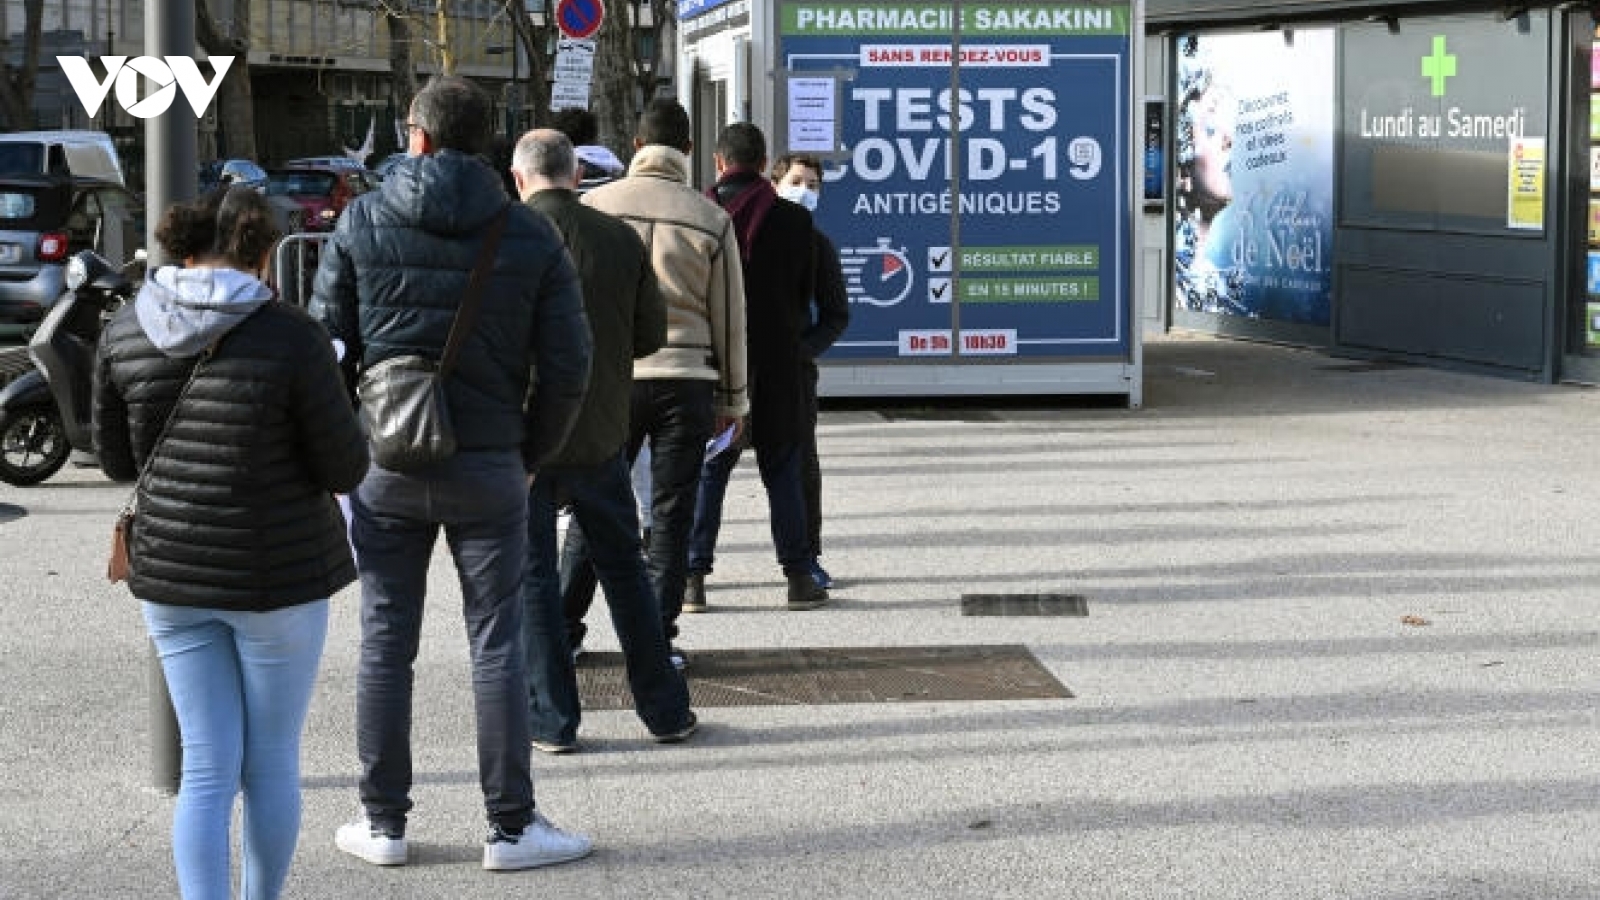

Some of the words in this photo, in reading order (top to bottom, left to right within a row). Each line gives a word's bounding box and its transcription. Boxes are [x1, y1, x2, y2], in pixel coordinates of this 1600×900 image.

[797, 7, 965, 30] PHARMACIE
[975, 7, 1112, 30] SAKAKINI
[868, 49, 914, 63] SANS
[920, 49, 1042, 63] RENDEZ-VOUS
[852, 88, 1058, 131] TESTS
[1361, 107, 1413, 137] Lundi
[1418, 115, 1441, 137] au
[1447, 107, 1524, 138] Samedi
[852, 189, 1061, 214] ANTIGÉNIQUES
[1231, 227, 1258, 267] de
[1264, 229, 1322, 271] Noël
[963, 252, 1036, 267] RÉSULTAT
[1041, 251, 1092, 265] FIABLE
[969, 283, 988, 296] EN
[994, 283, 1009, 296] 15
[1014, 282, 1079, 296] MINUTES
[909, 336, 926, 349] De
[965, 334, 1006, 349] 18h30
